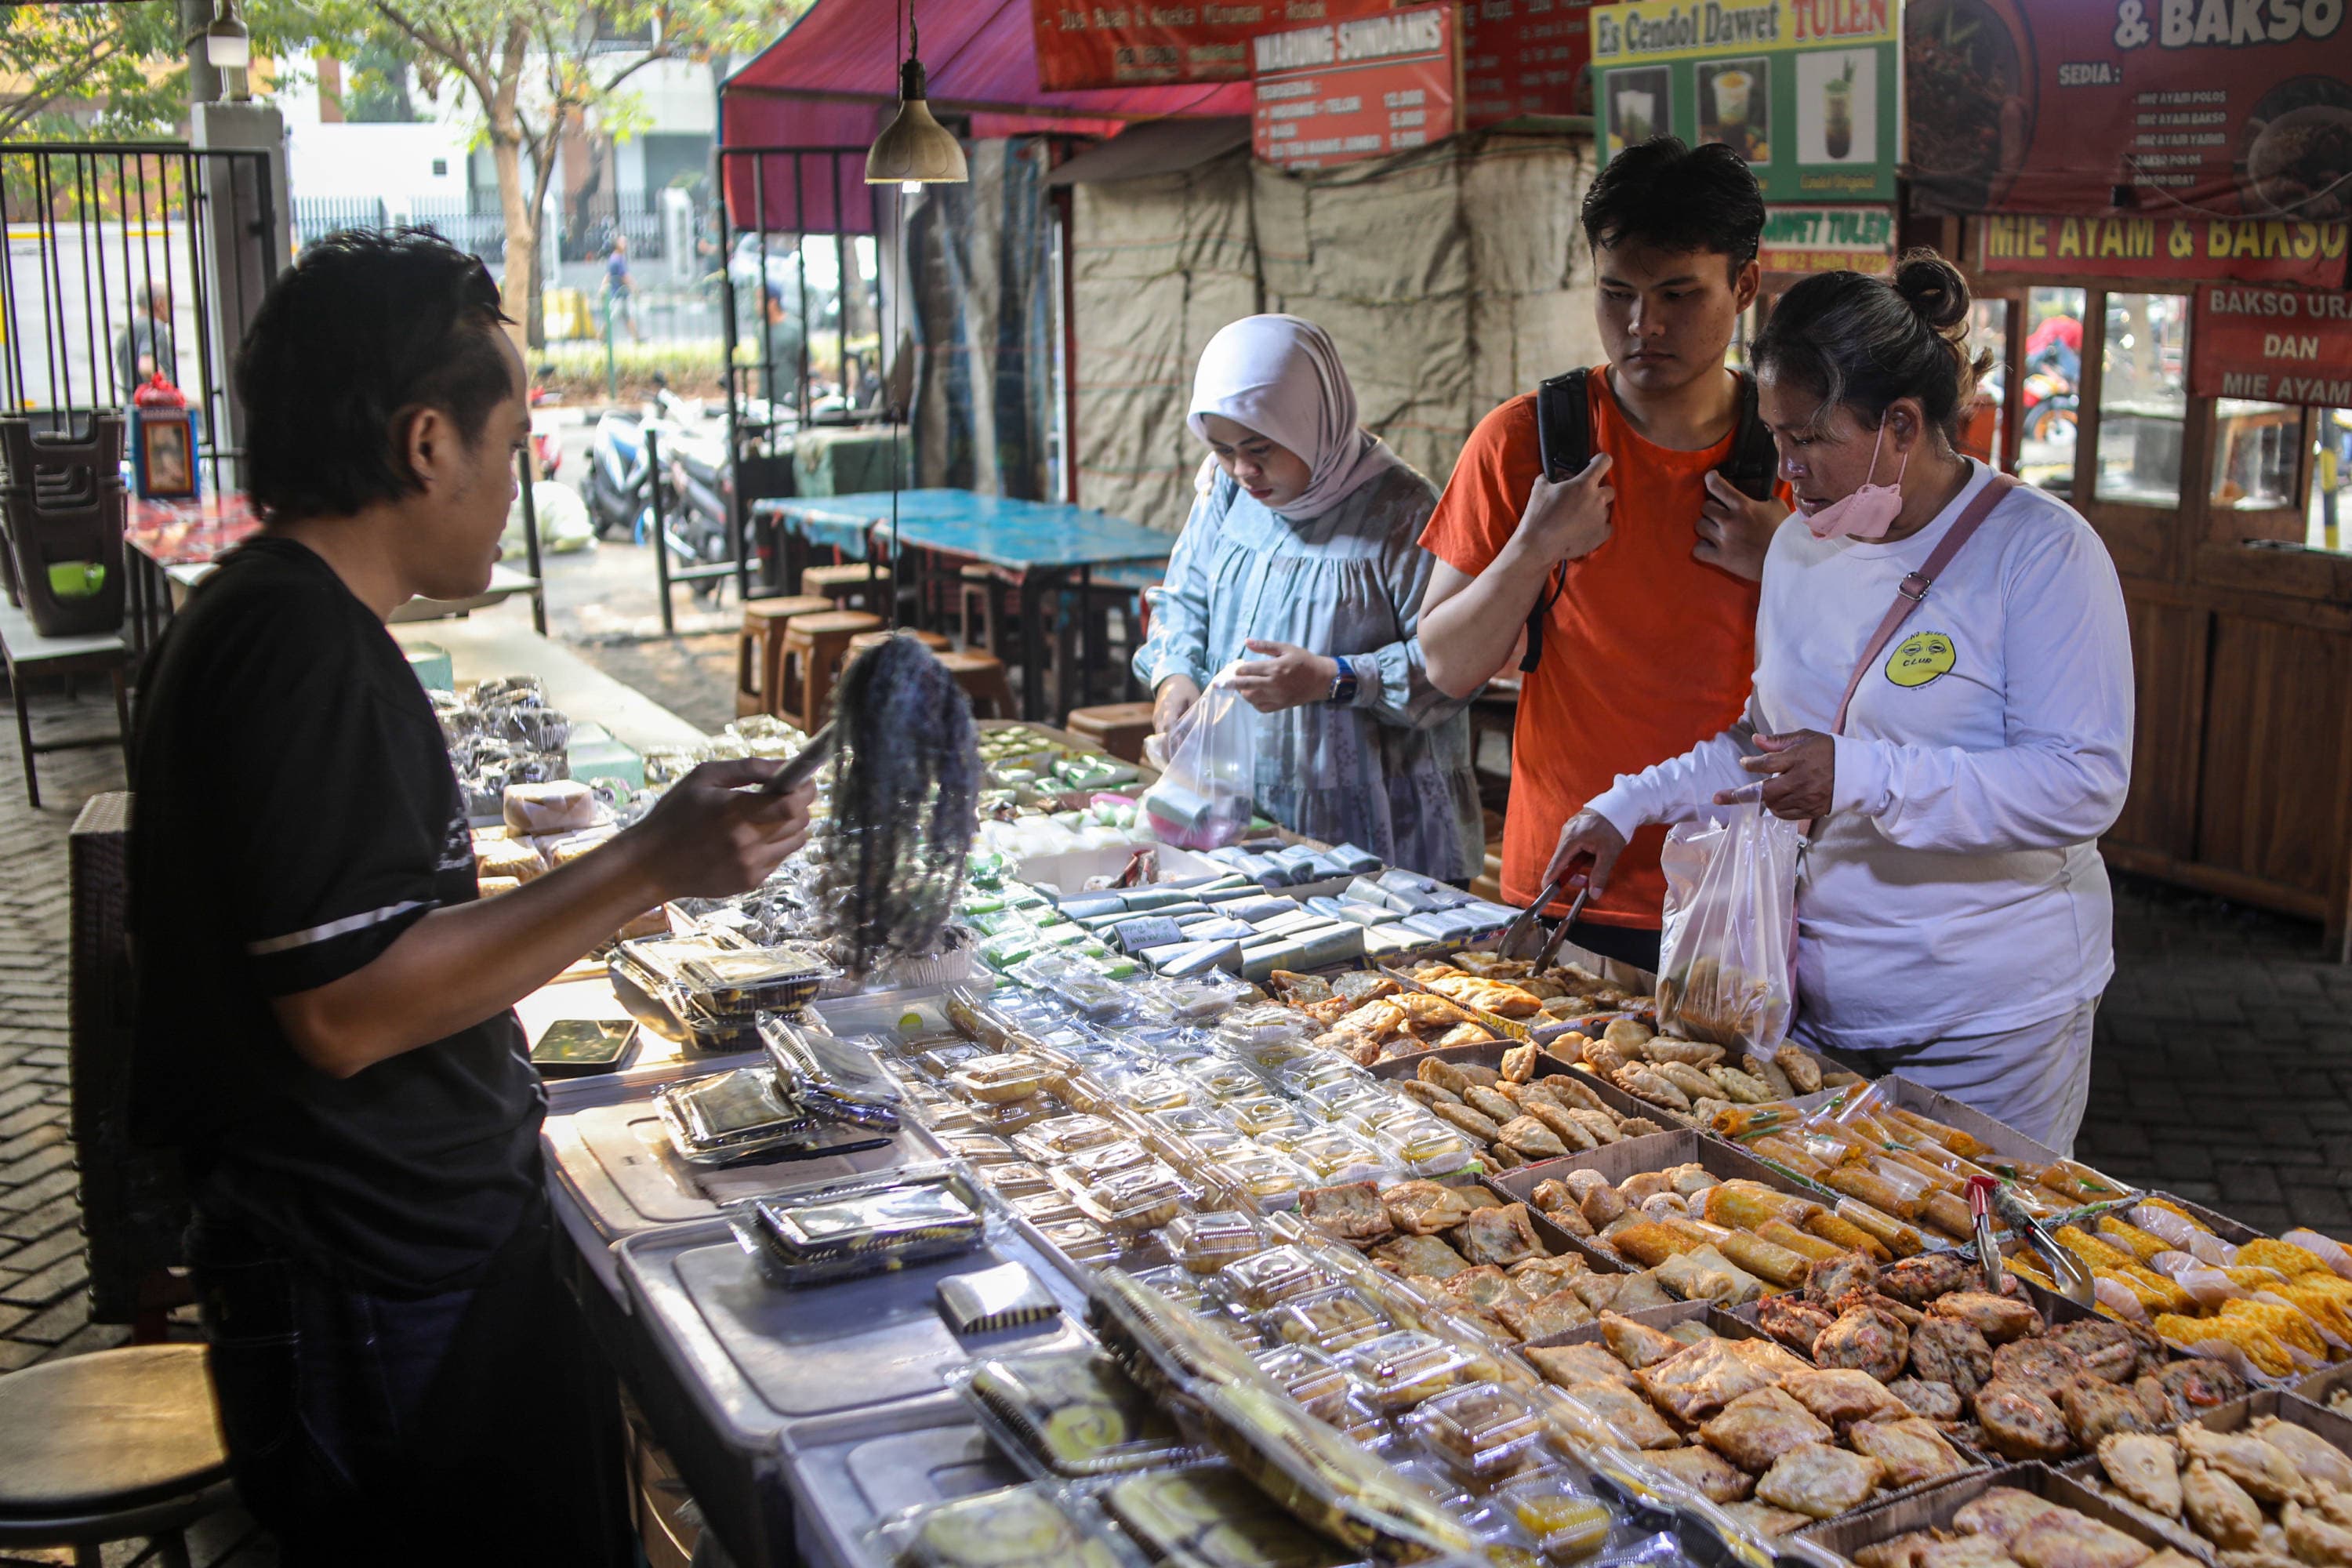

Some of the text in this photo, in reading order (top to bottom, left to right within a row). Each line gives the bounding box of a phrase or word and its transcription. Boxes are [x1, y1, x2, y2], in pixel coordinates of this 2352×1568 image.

[1597, 14, 1620, 56] Es
[1624, 5, 1699, 53] Cendol
[1704, 1, 1780, 45] Dawet
[1791, 0, 1888, 41] TULEN
[2114, 0, 2343, 48] & BAKSO
[1255, 24, 1334, 73] WARUNG
[2192, 90, 2227, 103] POLOS
[2191, 111, 2227, 124] BAKSO
[1989, 215, 2347, 260] MIE AYAM & BAKSO
[2209, 289, 2352, 319] BAKSO UR
[2263, 333, 2318, 361] DAN
[2222, 370, 2351, 405] MIE AYAM
